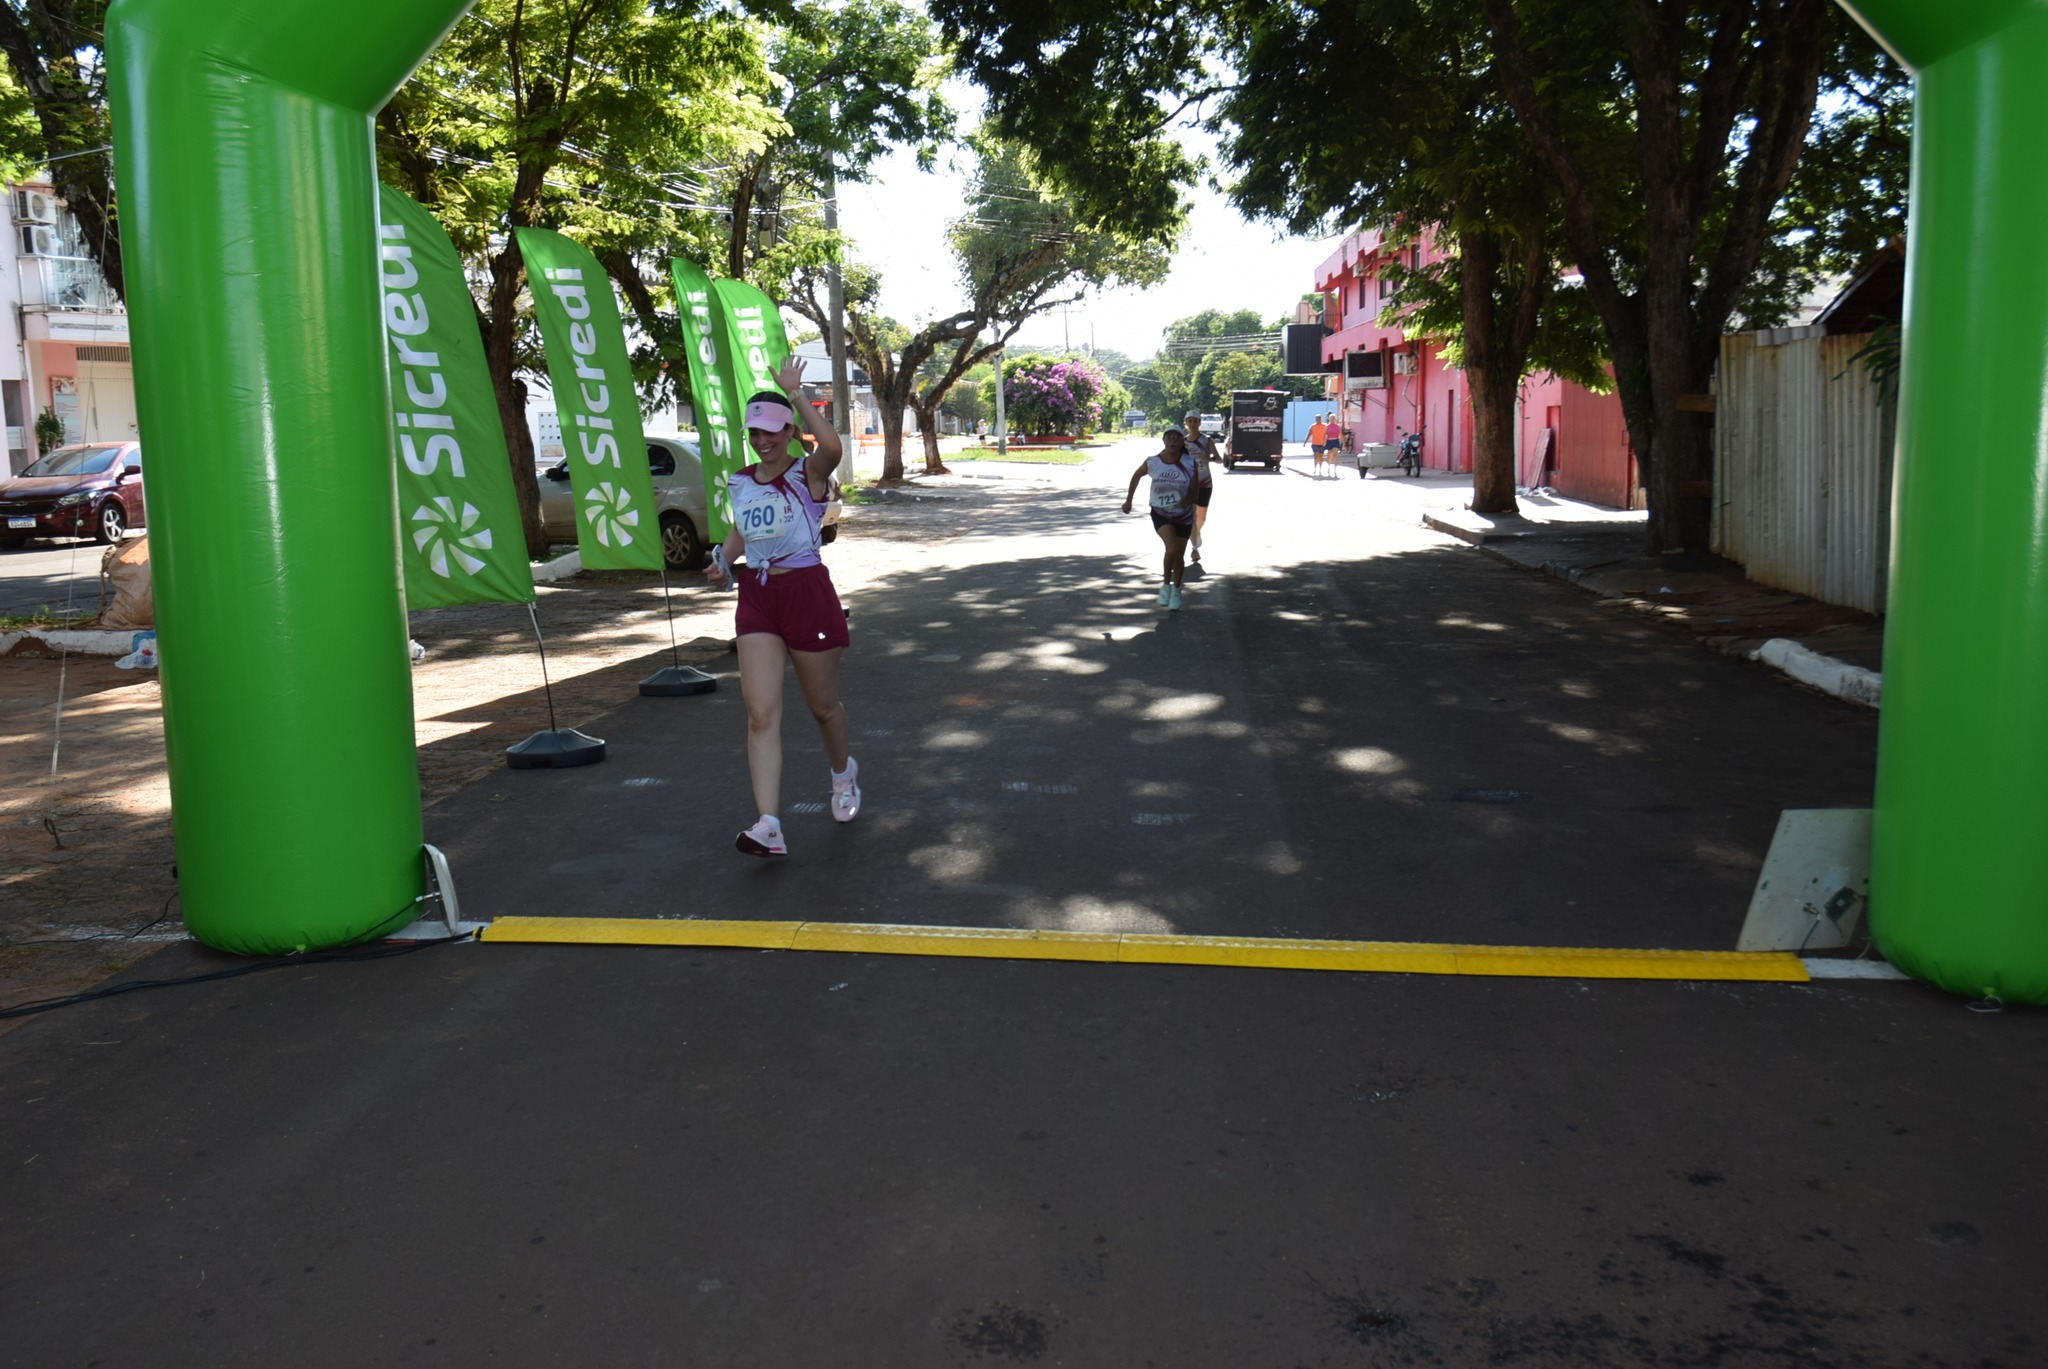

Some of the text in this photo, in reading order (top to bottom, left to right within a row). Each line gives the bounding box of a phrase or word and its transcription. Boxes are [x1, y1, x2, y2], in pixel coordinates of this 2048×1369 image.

[544, 268, 622, 469] Sicredi
[687, 290, 732, 460] Sicredi
[733, 304, 776, 389] redi
[742, 504, 775, 531] 760
[1158, 494, 1178, 506] 721
